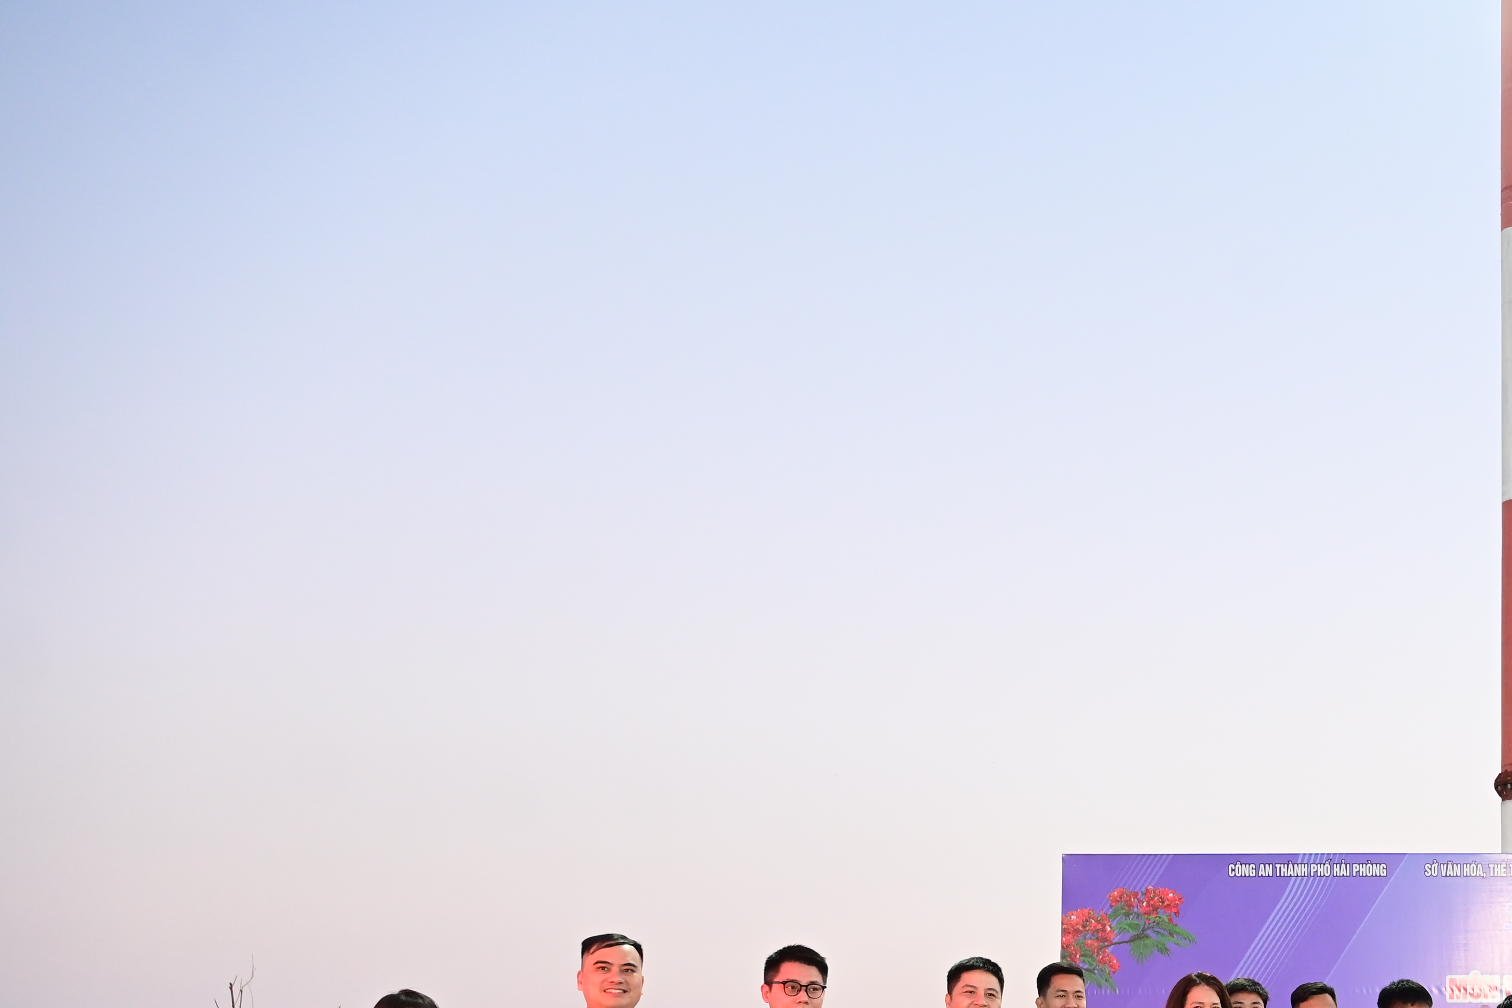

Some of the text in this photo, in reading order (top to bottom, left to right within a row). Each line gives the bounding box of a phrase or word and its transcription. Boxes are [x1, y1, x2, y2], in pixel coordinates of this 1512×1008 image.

[1228, 859, 1388, 877] CÔNG AN THÀNH PHỐ HẢI PHÒNG
[1424, 859, 1439, 877] SỞ
[1440, 861, 1461, 877] VĂN
